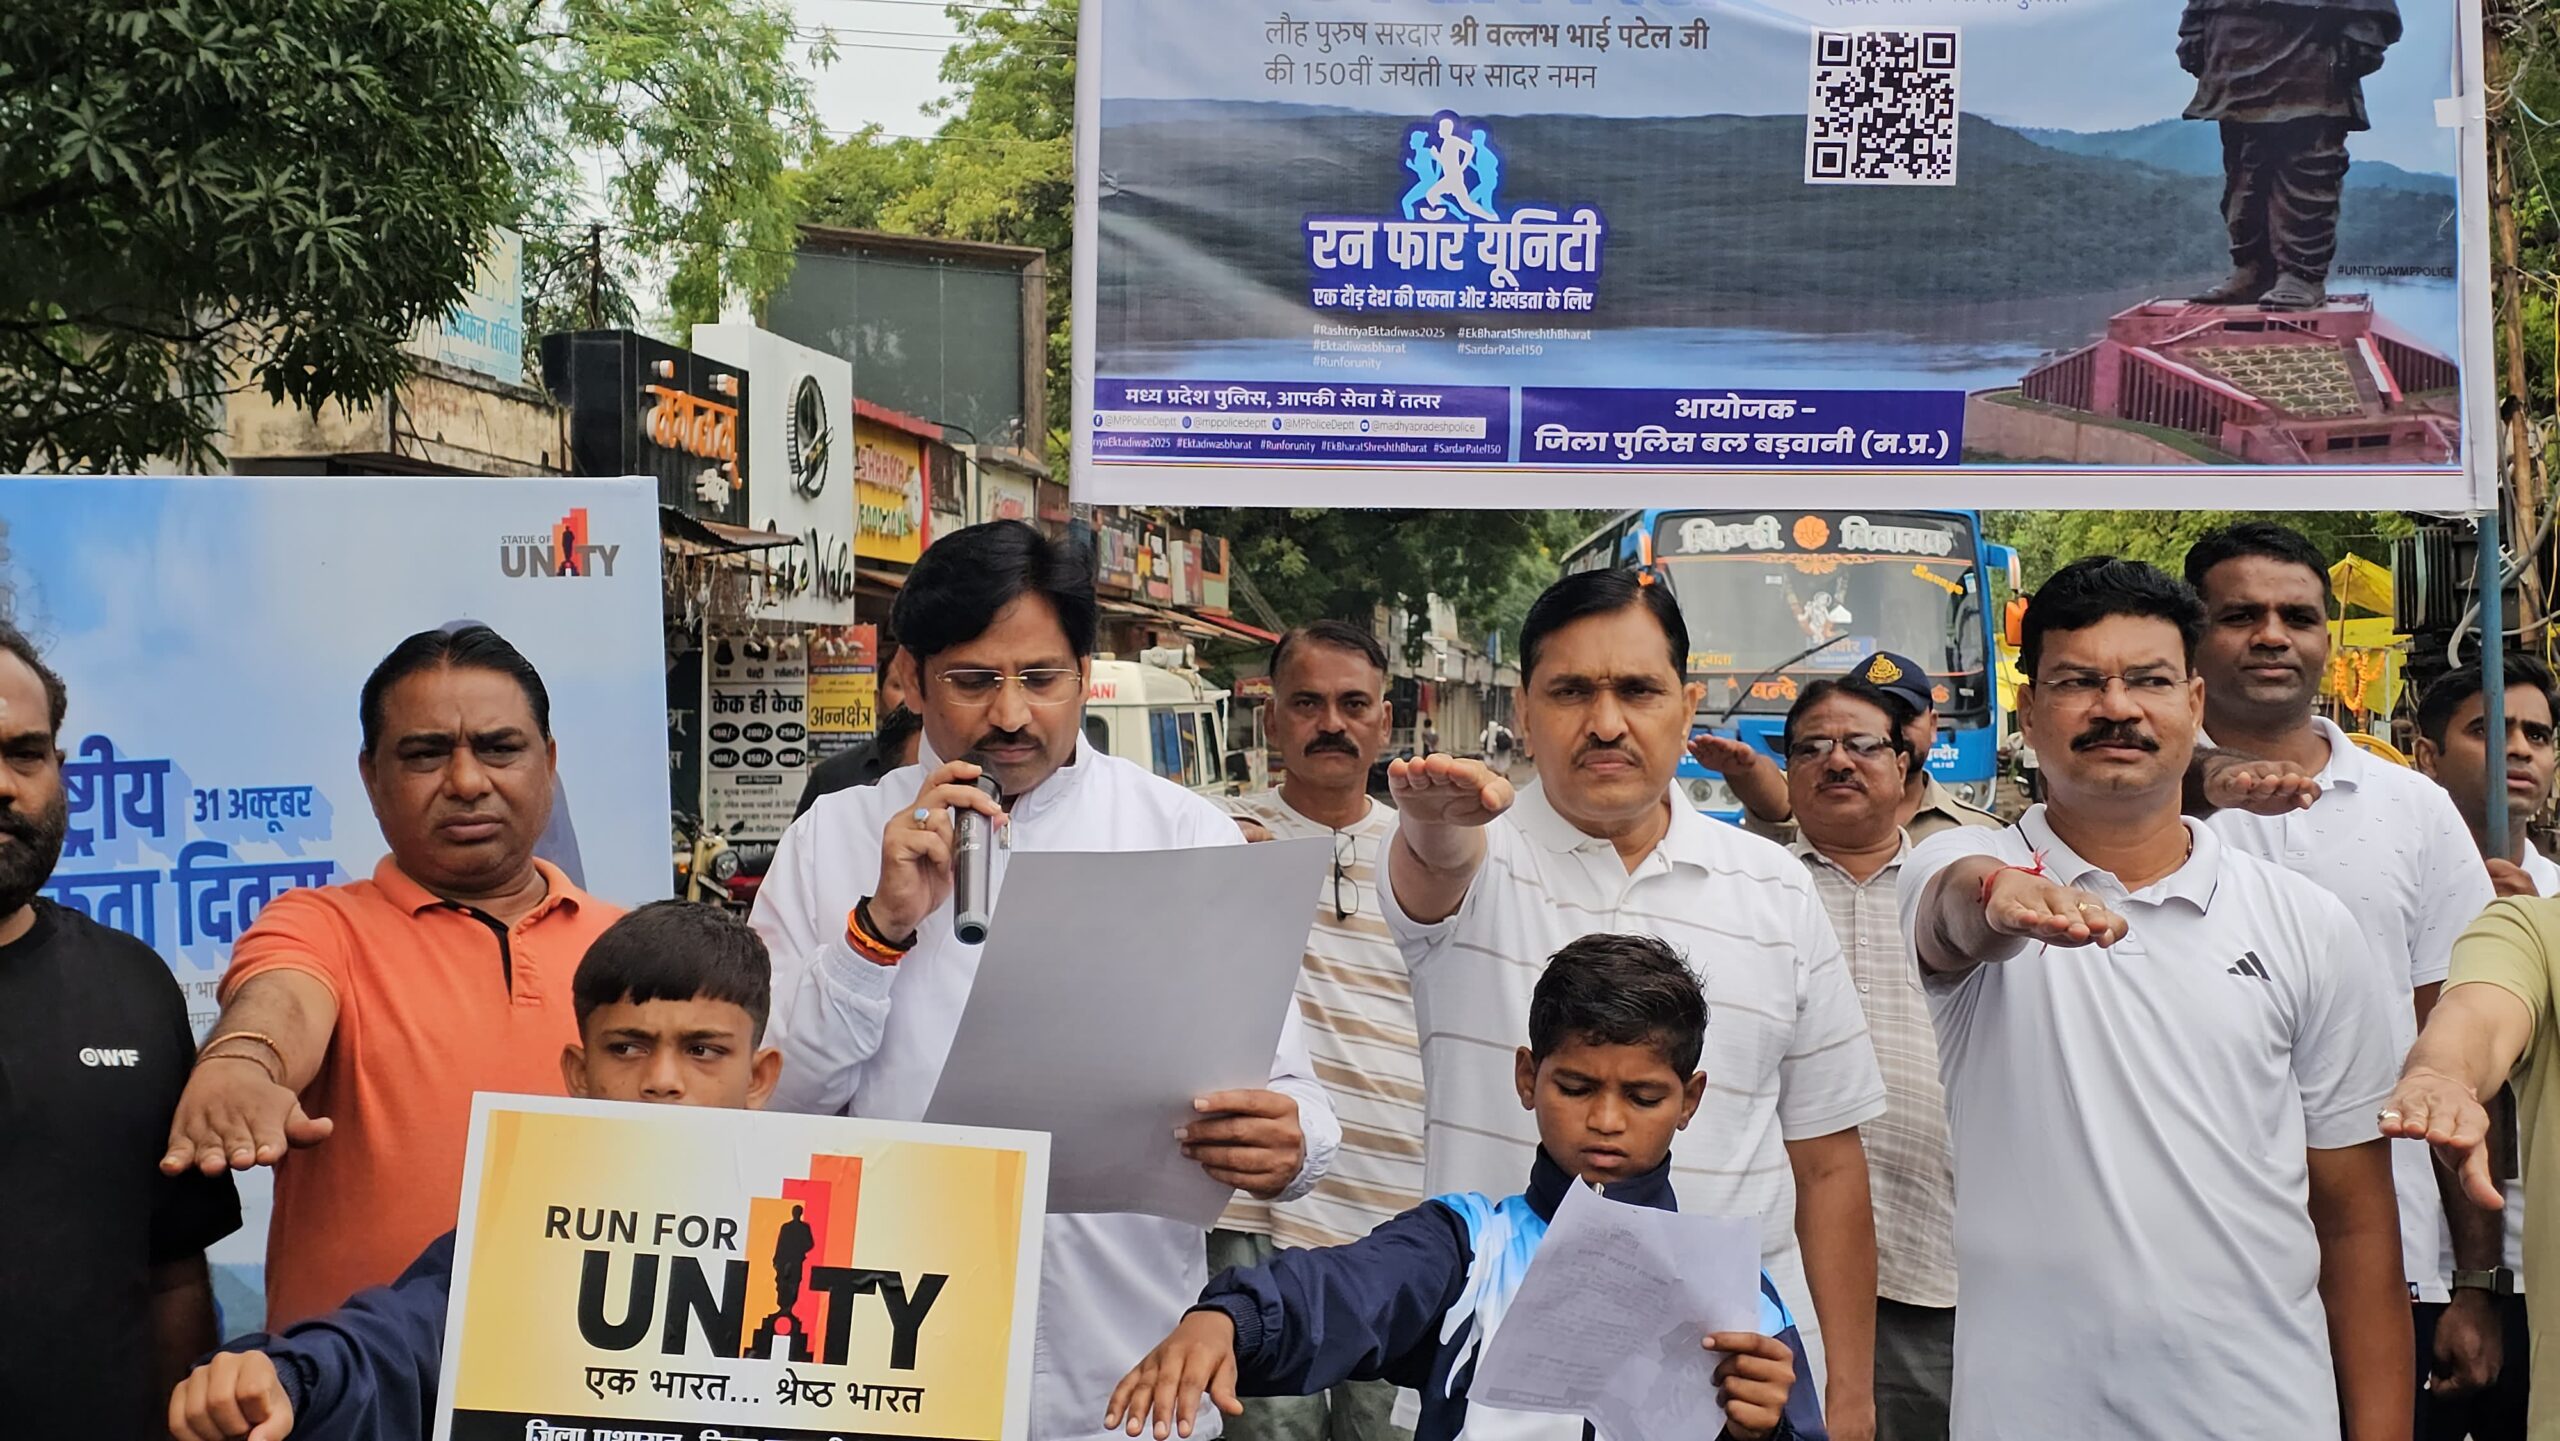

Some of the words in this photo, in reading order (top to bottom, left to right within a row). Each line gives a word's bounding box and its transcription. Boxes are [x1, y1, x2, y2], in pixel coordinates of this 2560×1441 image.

[1264, 12, 1309, 47] लौह
[1315, 21, 1368, 53] पुरुष
[1374, 22, 1443, 47] सरदार
[1450, 15, 1479, 47] श्री
[1485, 23, 1560, 48] वल्लभ
[1566, 16, 1612, 52] भाई
[1617, 16, 1673, 50] पटेल
[1678, 17, 1710, 50] जी
[1264, 53, 1295, 85] की
[1379, 56, 1443, 87] जयंती
[1448, 63, 1478, 88] पर
[1484, 64, 1541, 89] सादर
[1547, 65, 1598, 89] नमन
[1308, 220, 1379, 270] रन
[1383, 206, 1469, 271] फॉर
[1474, 208, 1602, 288] यूनिटी
[2336, 265, 2454, 278] #UNITYDAYMPPOLICE
[1313, 287, 1339, 307] एक
[1340, 283, 1365, 311] दौड़
[1367, 285, 1392, 308] देश
[1394, 284, 1415, 308] की
[1415, 288, 1456, 308] एकता
[1458, 285, 1487, 309] और
[1488, 286, 1544, 310] अखंडता
[1545, 286, 1562, 309] के
[1562, 287, 1594, 311] लिए
[1313, 324, 1446, 340] #RashtriyaEktadiwas2025
[1457, 327, 1592, 341] #EkBharatShreshthBharat
[1313, 340, 1407, 355] #Ektadiwasbharat
[1313, 355, 1382, 370] #Runforunity
[1125, 388, 1163, 405] मध्य
[1167, 385, 1210, 406] प्रदेश
[1214, 386, 1273, 410] पुलिस,
[1276, 387, 1336, 407] आपकी
[1340, 388, 1377, 408] सेवा
[1380, 388, 1396, 408] में
[1399, 393, 1442, 410] तत्पर
[1674, 392, 1797, 420] आयोजक
[1372, 420, 1476, 435] @madhyapradeshpolice
[1176, 436, 1252, 451] #Ektadiwasbharat
[1260, 438, 1316, 454] #Runforunity
[1534, 424, 1609, 453] जिला
[1612, 424, 1696, 460] पुलिस
[1700, 432, 1748, 454] बल
[1754, 426, 1855, 460] बड़वानी
[500, 535, 536, 545] STATUE
[538, 535, 552, 545] OF
[711, 688, 746, 714] केक
[748, 688, 768, 714] ही
[770, 688, 805, 714] केक
[193, 788, 219, 822] 31
[227, 785, 313, 833] अक्टूबर
[544, 1203, 638, 1247] RUN
[653, 1211, 738, 1252] FOR
[576, 1247, 950, 1371] UNITY
[584, 1366, 637, 1401] एक
[775, 1368, 836, 1408] श्रेष्ठ
[848, 1382, 926, 1415] भारत
